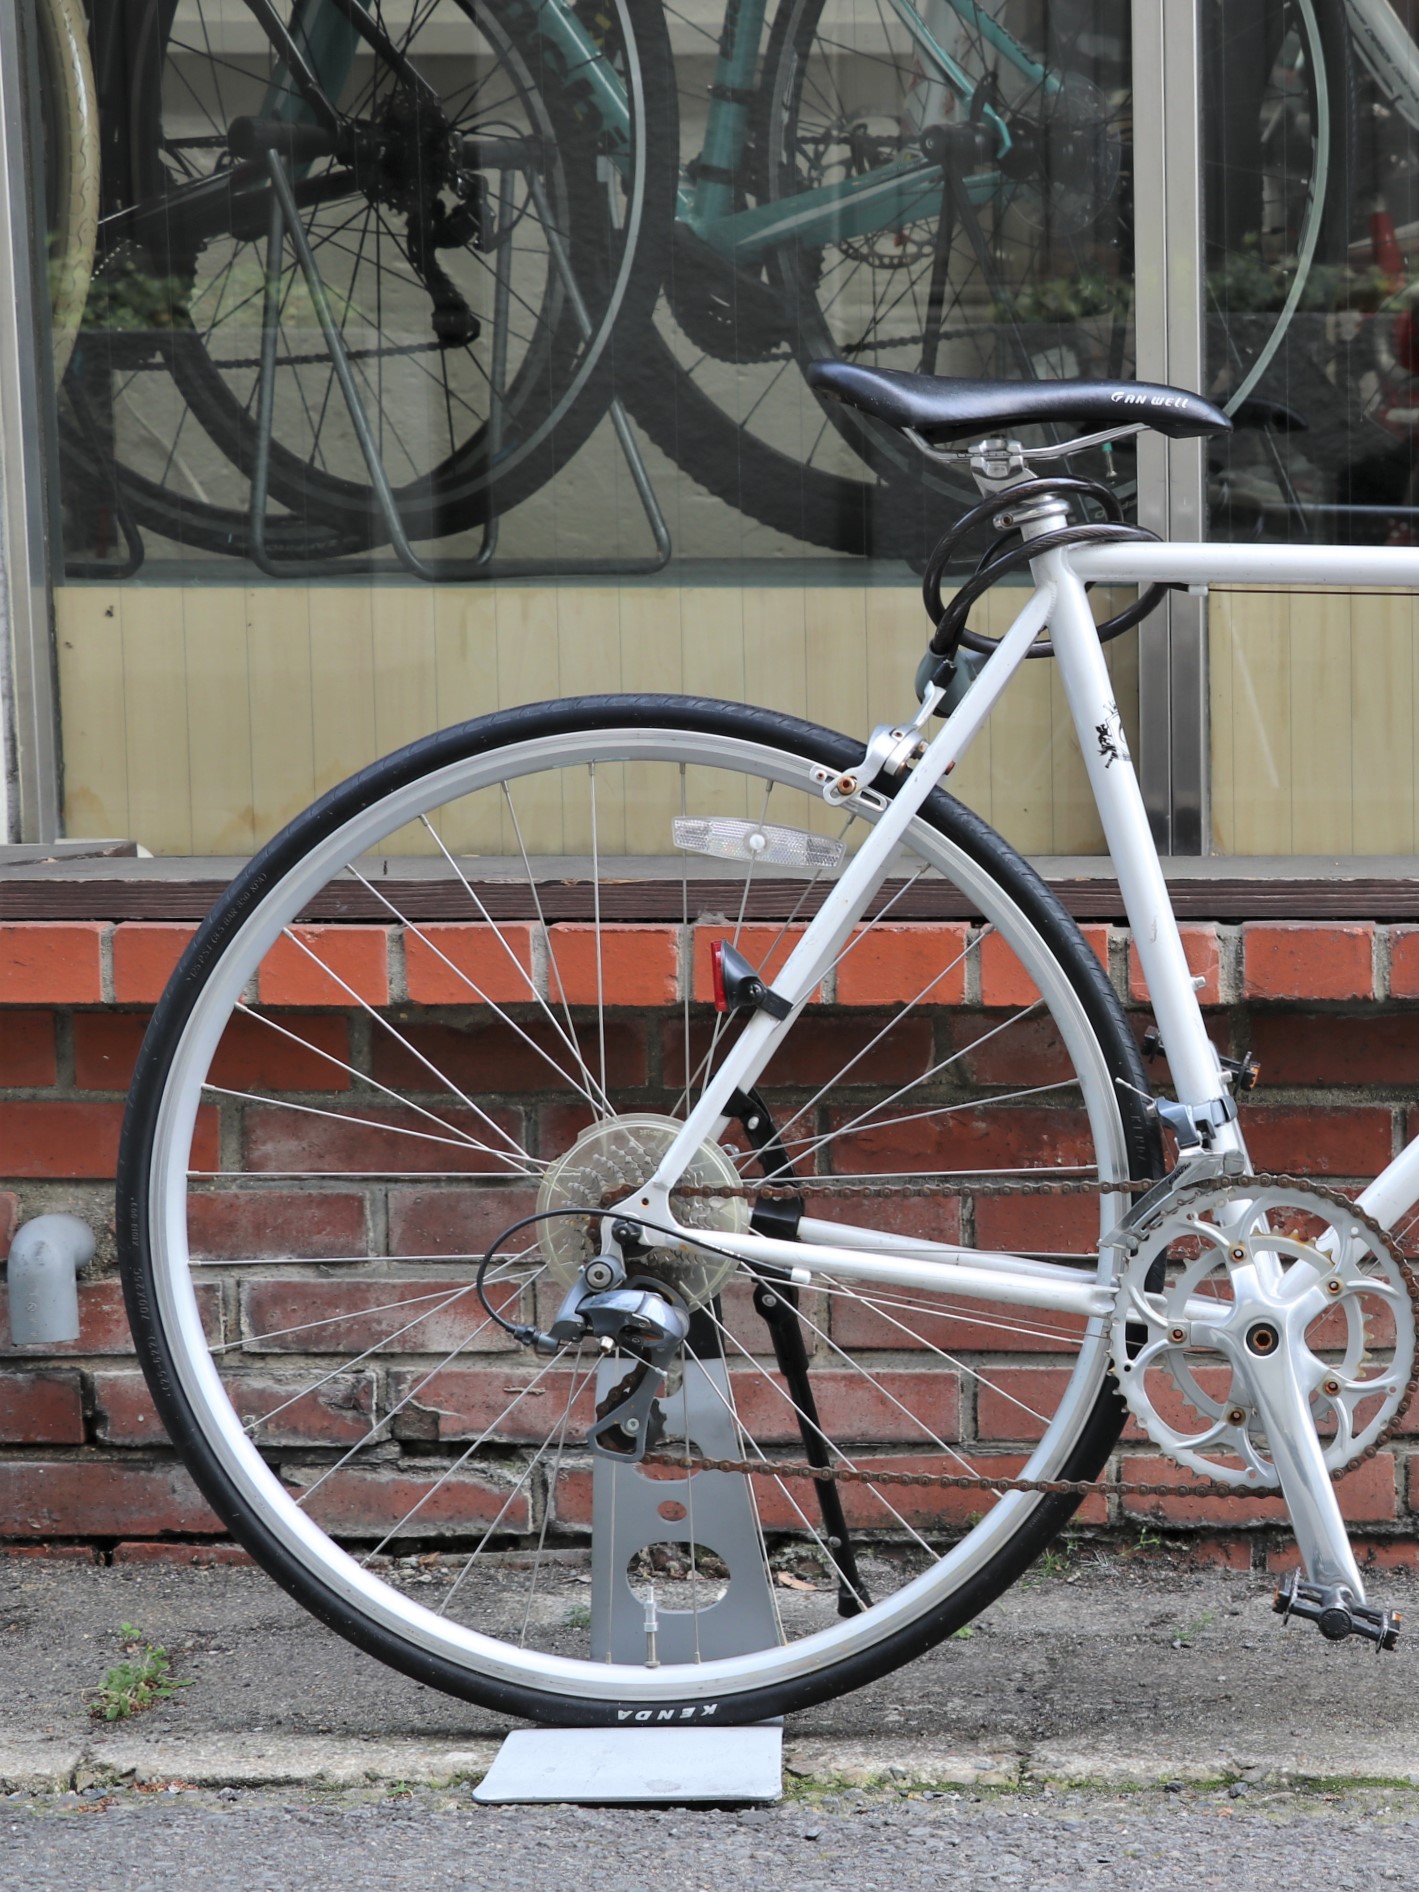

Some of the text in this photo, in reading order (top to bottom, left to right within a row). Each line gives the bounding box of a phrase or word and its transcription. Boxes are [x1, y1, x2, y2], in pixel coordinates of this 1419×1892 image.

[1110, 391, 1189, 409] GAN WELL
[617, 1703, 718, 1721] KENDA
